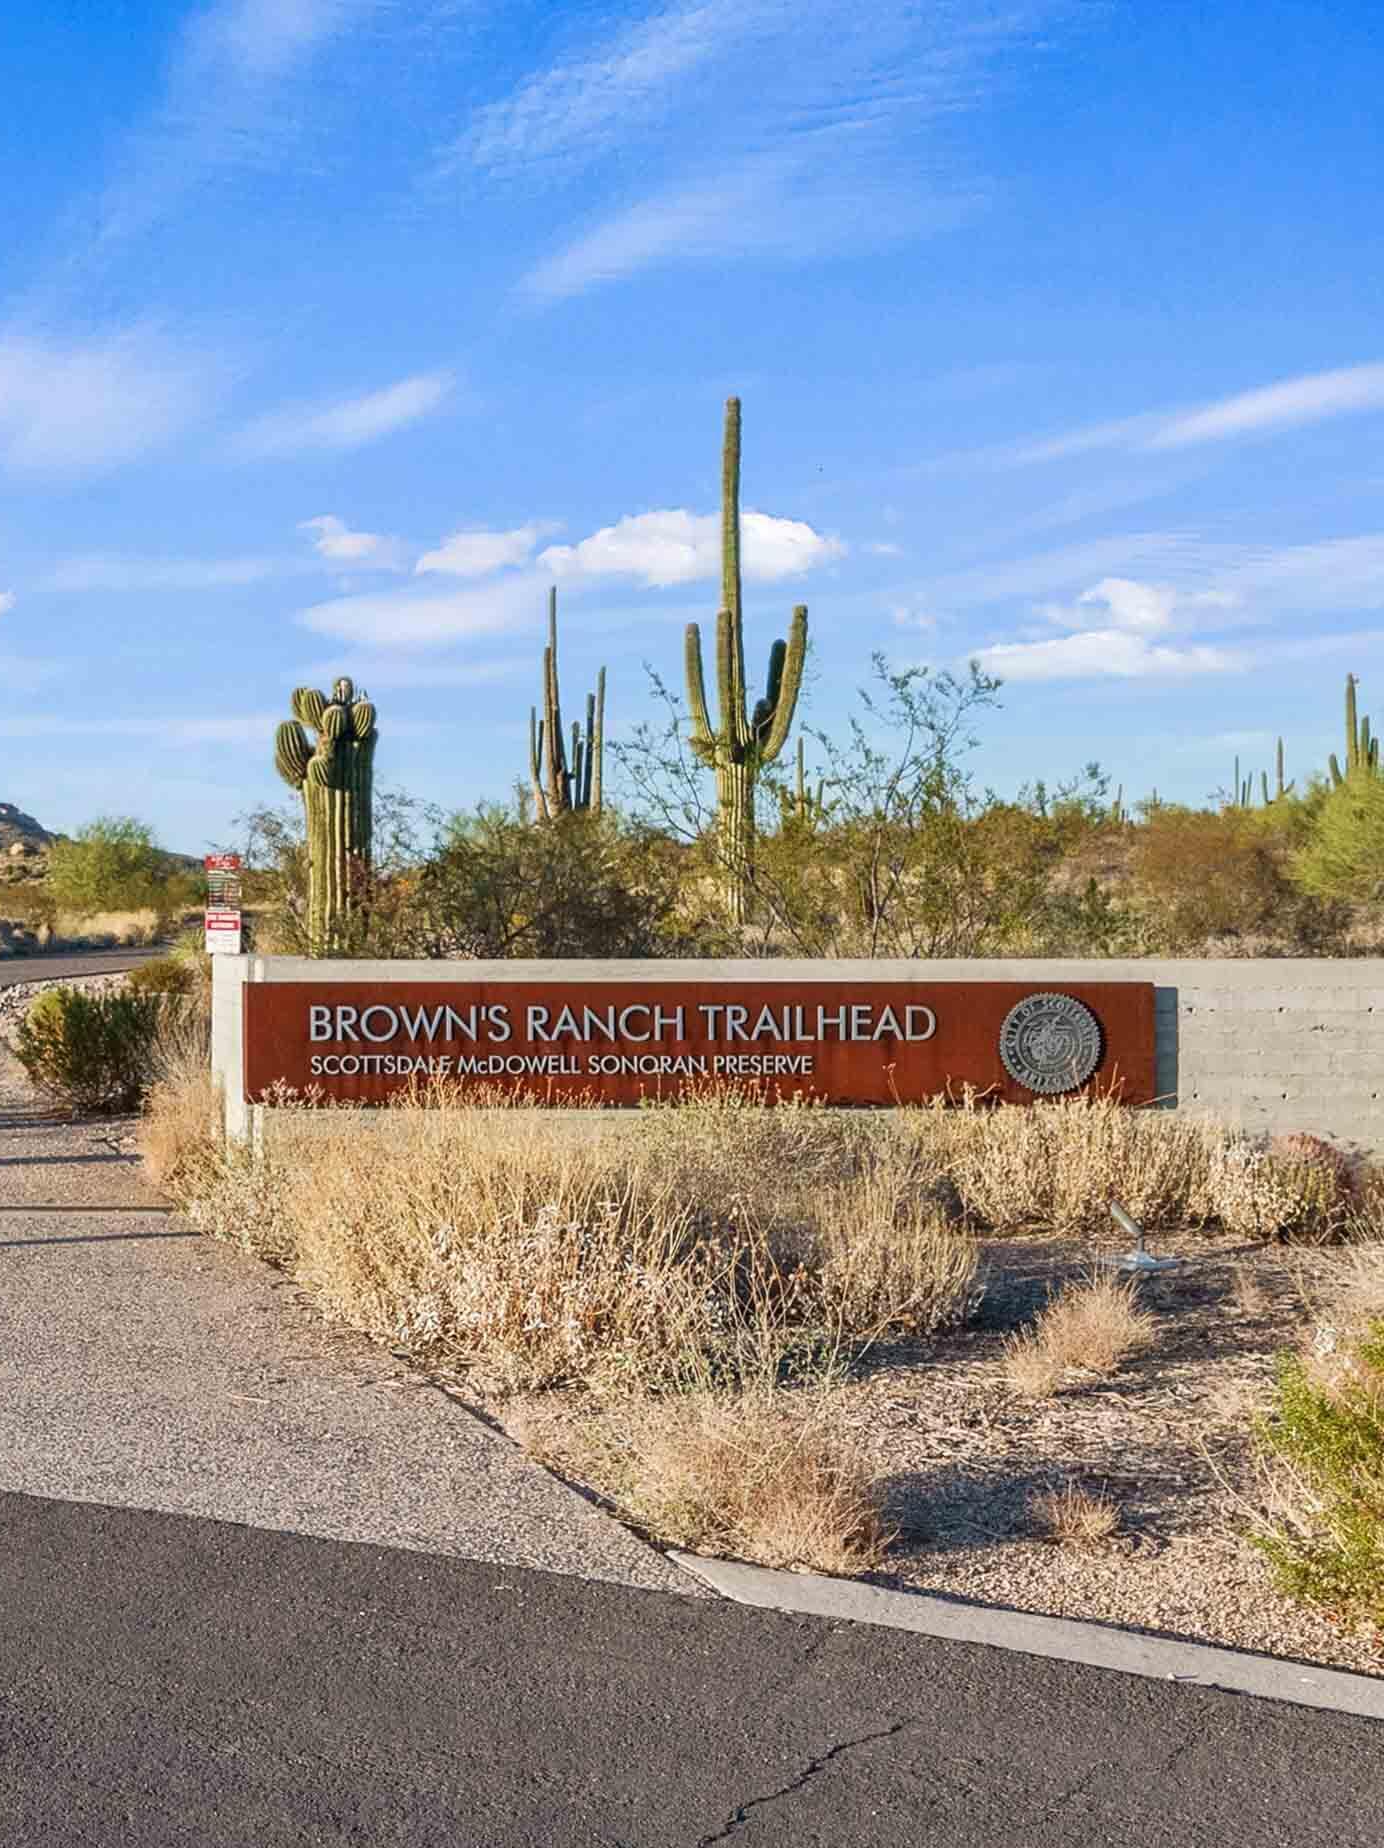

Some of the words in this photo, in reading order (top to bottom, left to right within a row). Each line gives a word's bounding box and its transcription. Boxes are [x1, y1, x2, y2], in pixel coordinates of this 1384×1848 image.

[310, 1005, 510, 1042] BROWN'S
[527, 1005, 683, 1042] RANCH
[698, 1005, 936, 1042] TRAILHEAD
[311, 1055, 450, 1075] SCOTTSDALE
[457, 1055, 582, 1075] McDOWELL
[588, 1055, 704, 1075] SONORAN
[714, 1055, 813, 1075] PRESERVE
